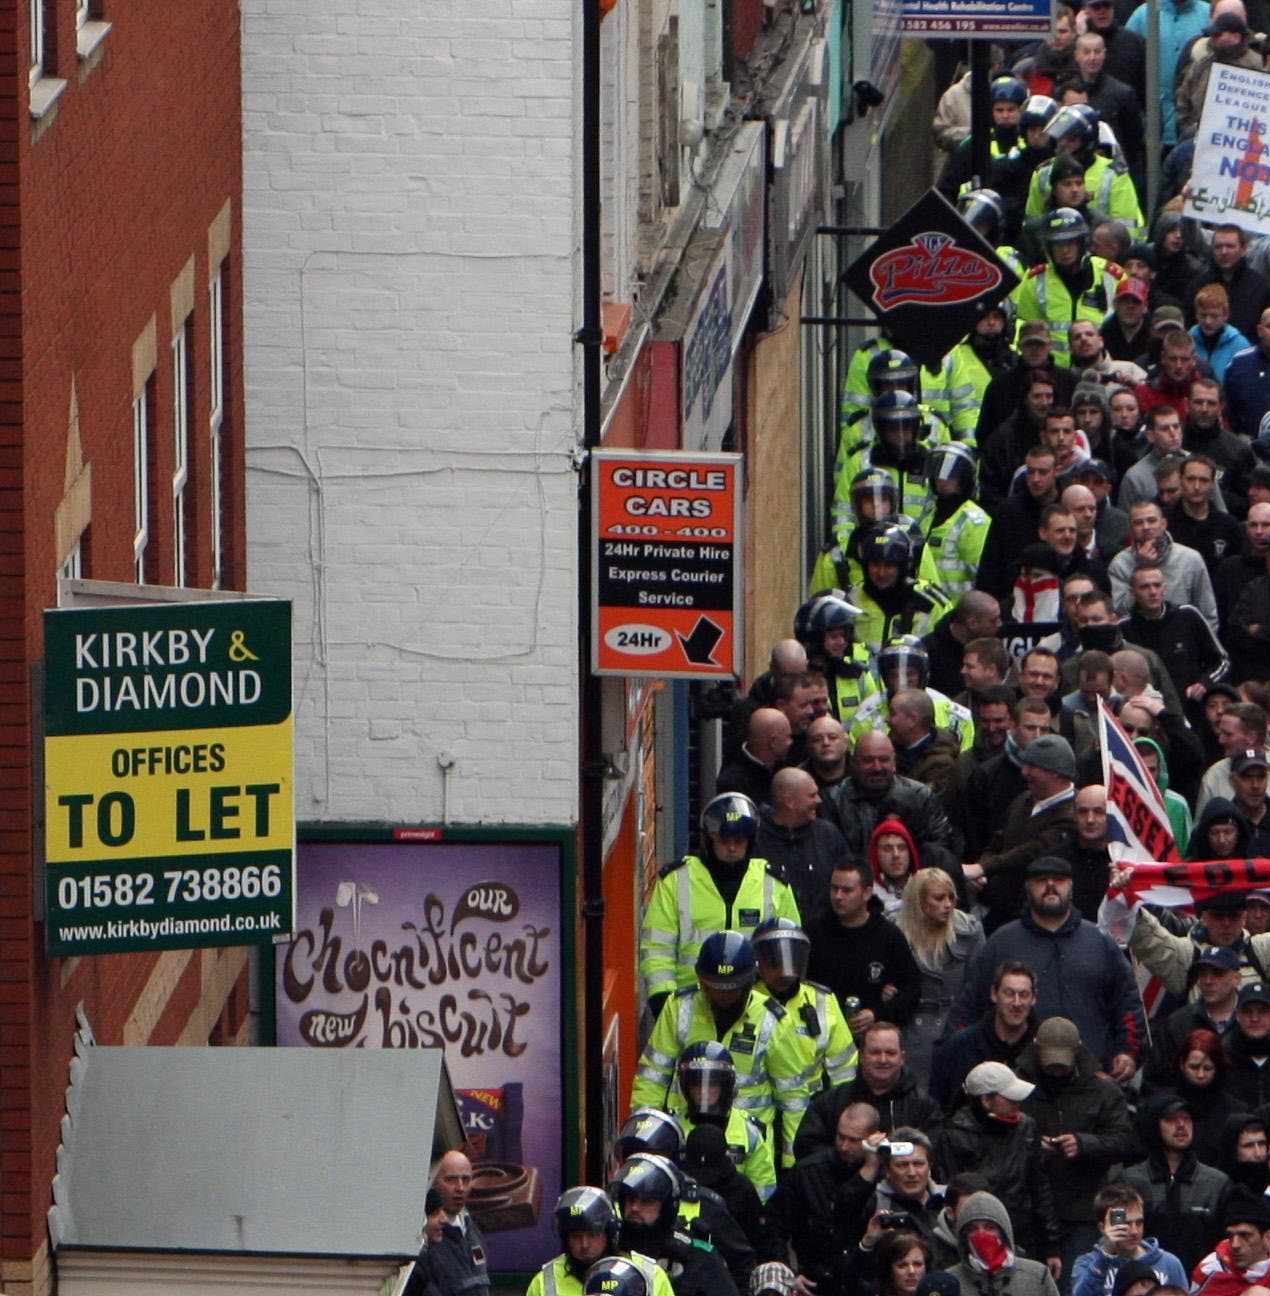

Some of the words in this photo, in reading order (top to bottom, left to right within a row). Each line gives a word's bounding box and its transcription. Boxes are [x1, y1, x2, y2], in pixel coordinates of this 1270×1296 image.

[1217, 82, 1270, 101] DEFENCE
[1215, 95, 1268, 113] LEAGUE
[1226, 115, 1267, 135] THIS
[612, 468, 727, 490] CIRCLE
[625, 496, 711, 518] CARS
[608, 524, 658, 536] 400
[677, 526, 727, 538] 400
[605, 543, 639, 557] 24Hr
[644, 544, 695, 559] Private
[699, 547, 730, 560] Hire
[609, 566, 666, 582] Express
[671, 569, 724, 583] Courier
[638, 591, 694, 605] Service
[76, 628, 215, 669] KIRKBY
[229, 630, 260, 662] &
[617, 632, 661, 648] 24Hr
[76, 670, 261, 713] DIAMOND
[112, 743, 225, 778] OFFICES
[58, 790, 135, 849] TO
[175, 783, 280, 842] LET
[58, 873, 154, 910] 01582
[163, 864, 282, 903] 738866
[59, 911, 280, 942] www.kirkbydiamond.co.uk
[718, 964, 733, 975] MP
[309, 1013, 357, 1043] new
[602, 1280, 618, 1292] MP
